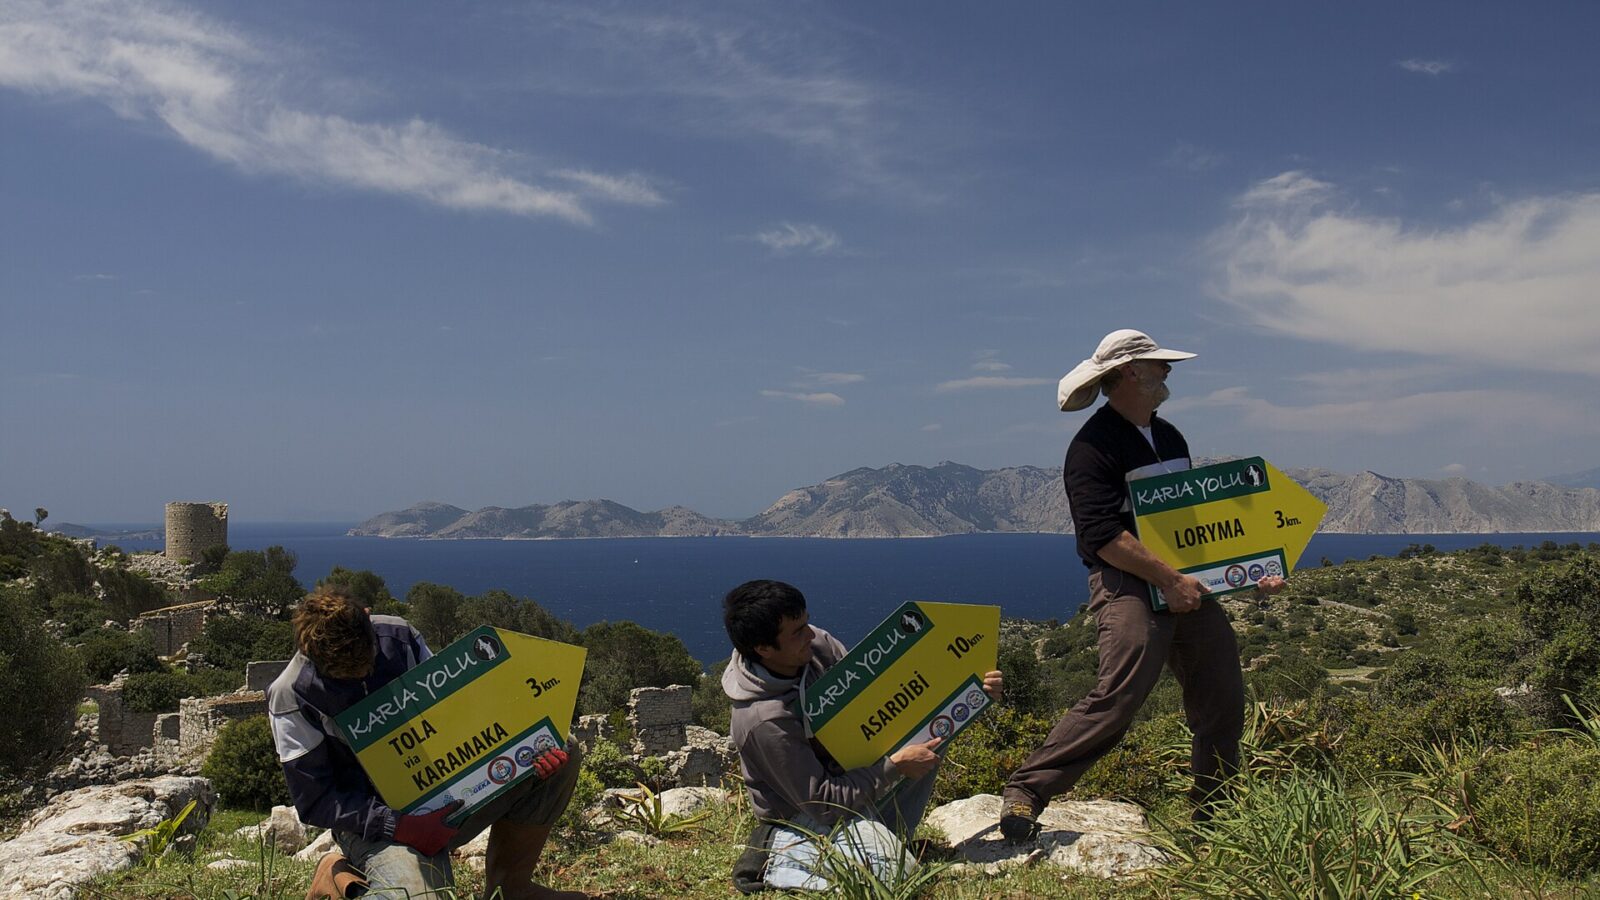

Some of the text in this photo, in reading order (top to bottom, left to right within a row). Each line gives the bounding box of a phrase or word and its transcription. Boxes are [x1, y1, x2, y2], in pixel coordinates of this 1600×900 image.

[1136, 472, 1245, 506] KARIA YOLU
[1174, 518, 1245, 549] LORYMA
[803, 628, 906, 722] KARIA YOLU
[348, 652, 478, 740] KARIA YOLU
[388, 719, 438, 756] TOLA
[403, 754, 421, 769] via
[411, 722, 509, 792] KARAMAKA
